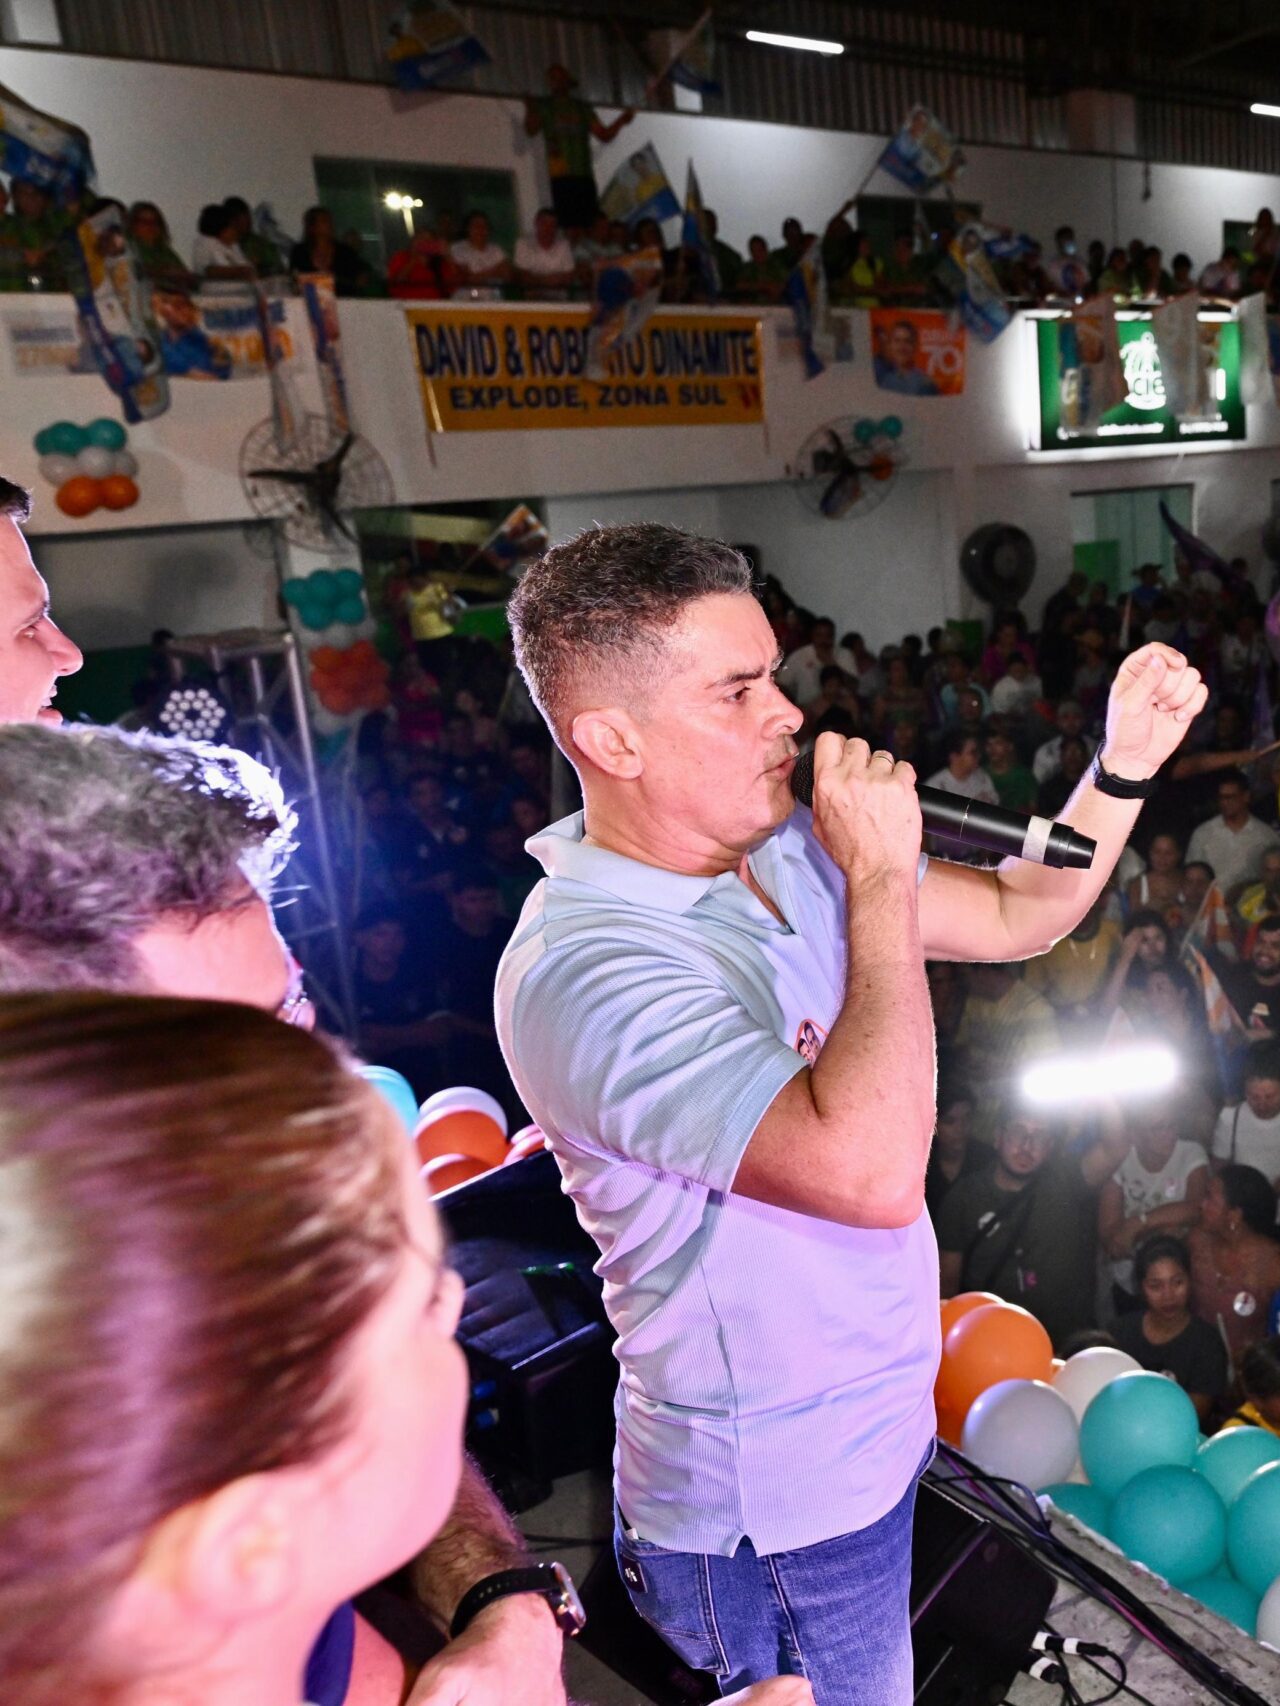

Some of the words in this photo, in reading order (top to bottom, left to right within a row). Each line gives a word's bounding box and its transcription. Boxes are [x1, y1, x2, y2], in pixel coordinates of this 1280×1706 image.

[415, 324, 498, 376] DAVID
[506, 326, 524, 376] &
[650, 328, 759, 377] DINAMITE
[920, 345, 962, 376] 70
[450, 386, 590, 411] EXPLODE,
[598, 384, 670, 409] ZONA
[678, 383, 728, 407] SUL
